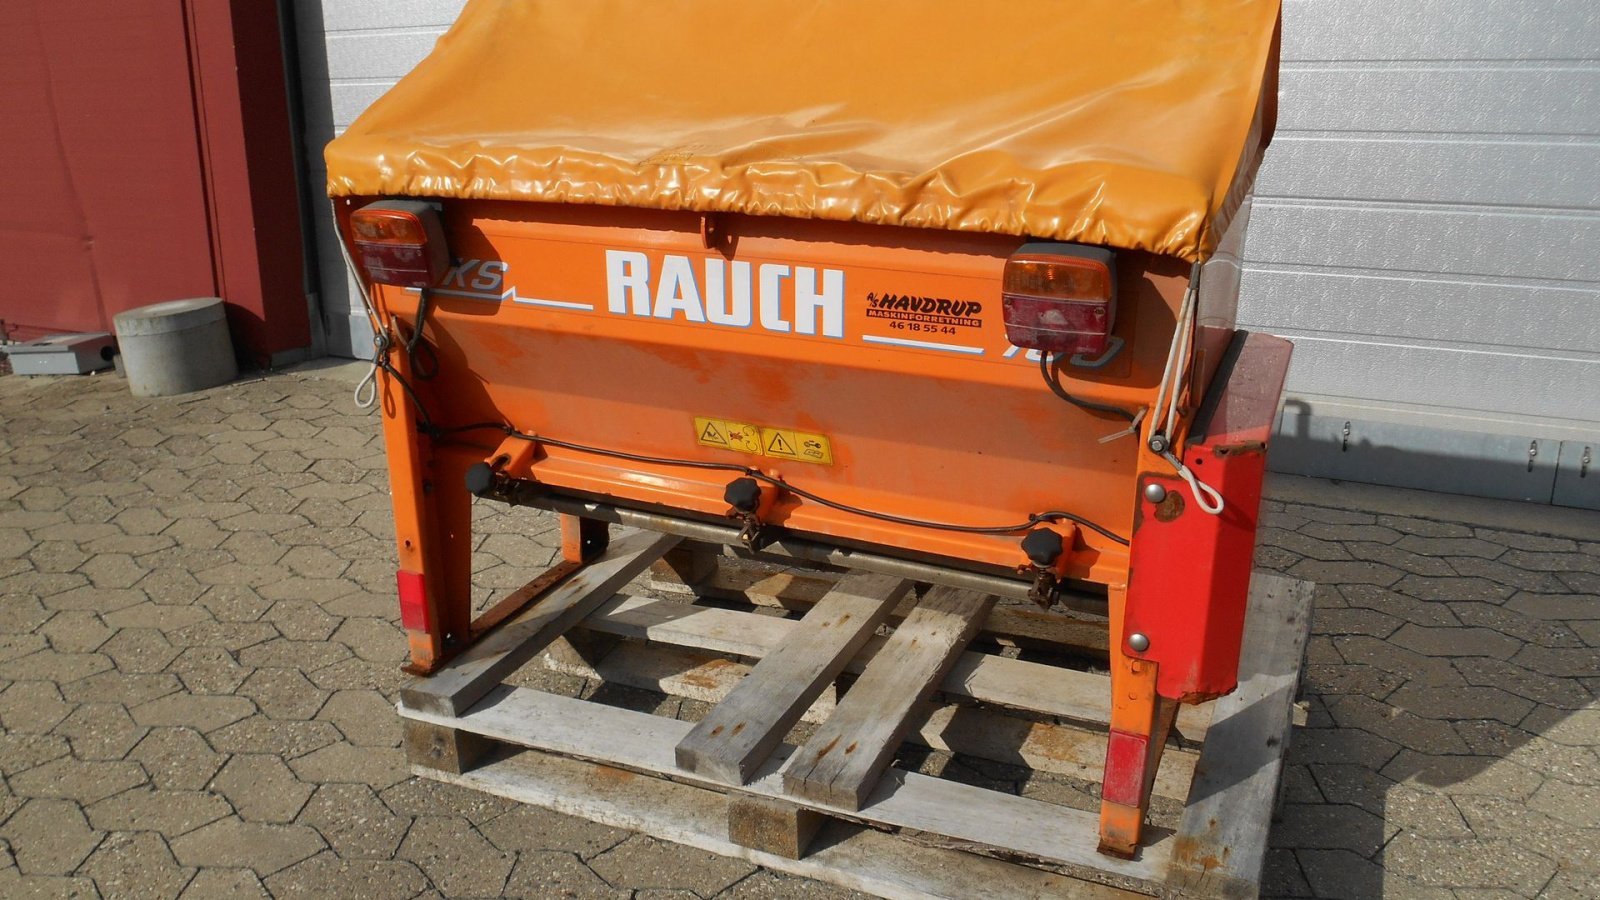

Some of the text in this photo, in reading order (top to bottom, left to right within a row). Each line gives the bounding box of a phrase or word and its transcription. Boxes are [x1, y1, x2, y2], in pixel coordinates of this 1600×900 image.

[605, 249, 845, 338] RAUCH
[879, 293, 982, 317] HAVDRUP
[867, 309, 981, 327] MASKINFORRETNING
[889, 321, 956, 335] 46 18 55 44
